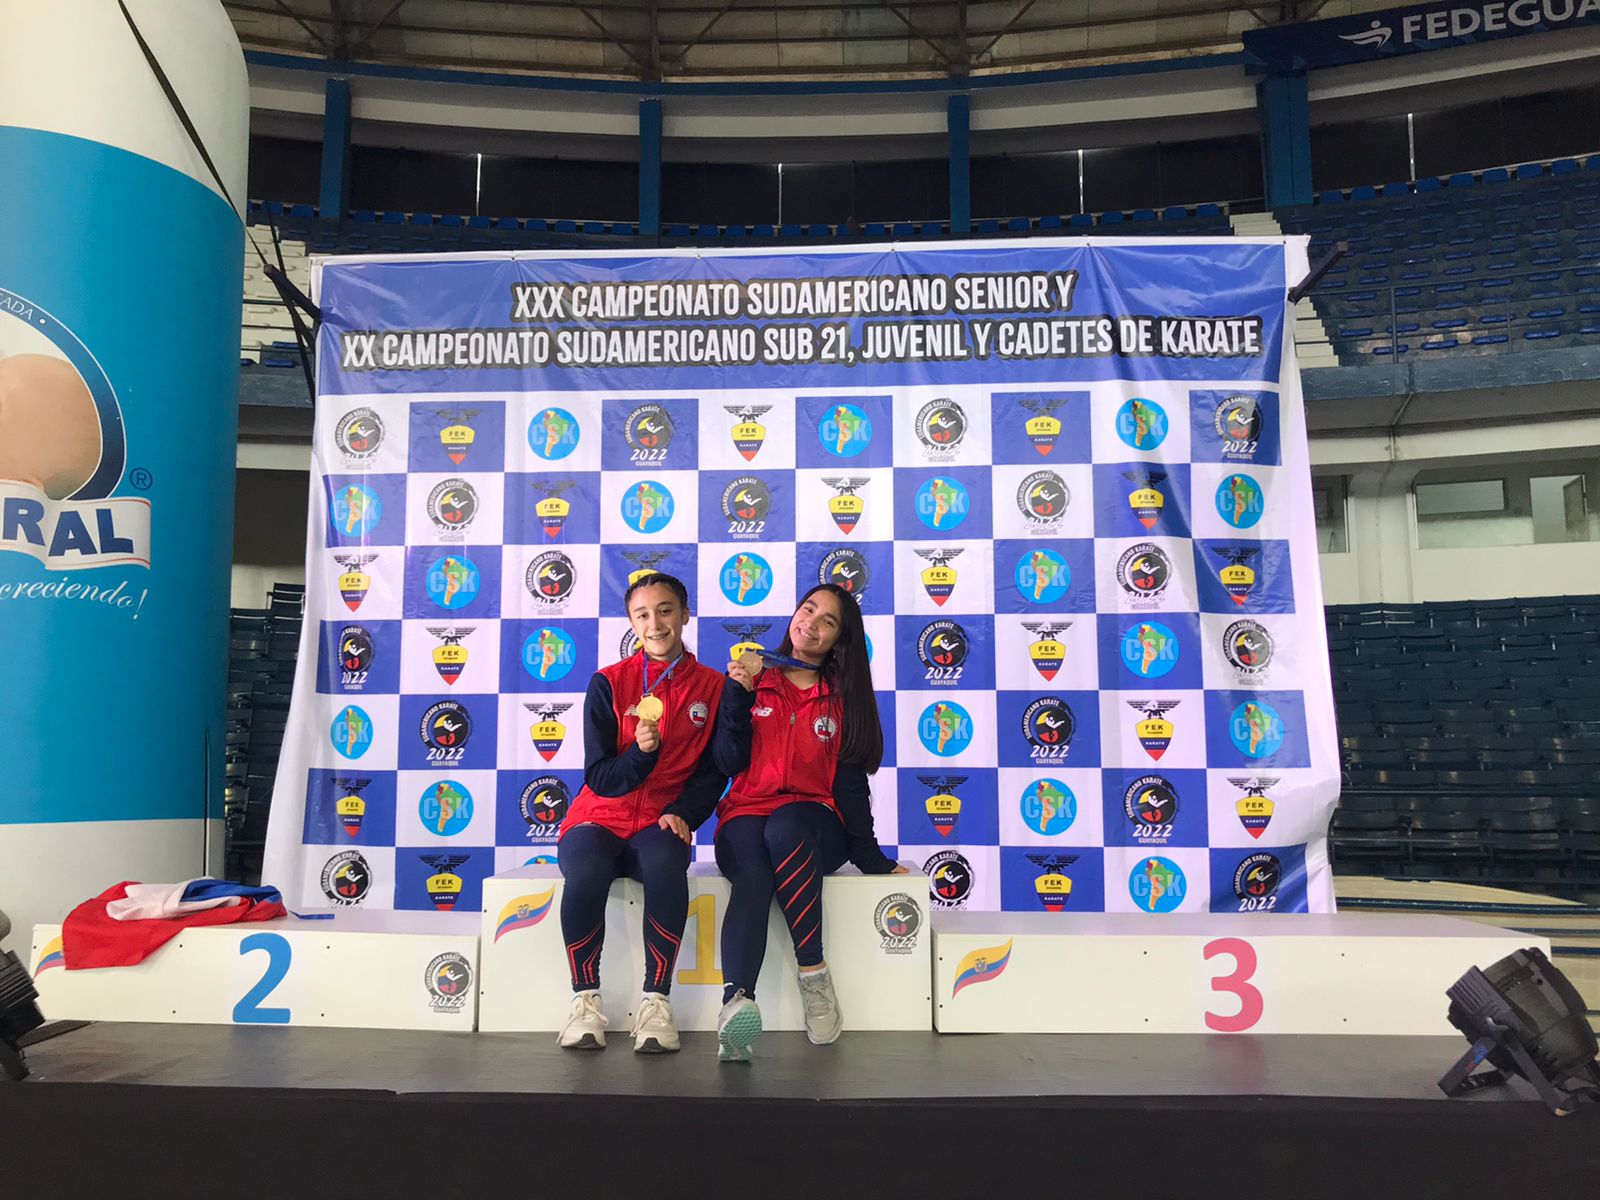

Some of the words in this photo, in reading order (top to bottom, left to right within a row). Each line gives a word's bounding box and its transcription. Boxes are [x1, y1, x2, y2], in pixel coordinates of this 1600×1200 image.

[1403, 0, 1600, 43] FEDEGUA
[514, 286, 564, 318] XXX
[572, 283, 739, 317] CAMPEONATO
[747, 278, 947, 315] SUDAMERICANO
[955, 275, 1051, 310] SENIOR
[1055, 273, 1074, 309] Y
[0, 294, 33, 320] ADA
[343, 334, 376, 367] XX
[382, 331, 549, 367] CAMPEONATO
[557, 329, 756, 364] SUDAMERICANO
[763, 327, 813, 361] SUB
[820, 326, 854, 363] 21,
[862, 323, 967, 359] JUVENIL
[974, 323, 991, 356] Y
[998, 320, 1112, 356] CADETES
[1120, 320, 1153, 353] DE
[1161, 320, 1259, 354] KARATE
[1221, 441, 1257, 453] 2022
[630, 448, 667, 461] 2022
[2, 497, 134, 557] RAL
[728, 520, 765, 533] 2022
[0, 576, 148, 620] creciendo!
[925, 667, 963, 679] 2022
[427, 747, 465, 760] 2022
[1030, 745, 1069, 758] 2022
[1133, 824, 1173, 837] 2022
[1239, 897, 1276, 911] 2022
[677, 894, 724, 984] 1
[880, 936, 917, 948] 2022
[232, 933, 292, 1024] 2
[1203, 937, 1264, 1033] 3
[429, 995, 465, 1008] 2022
